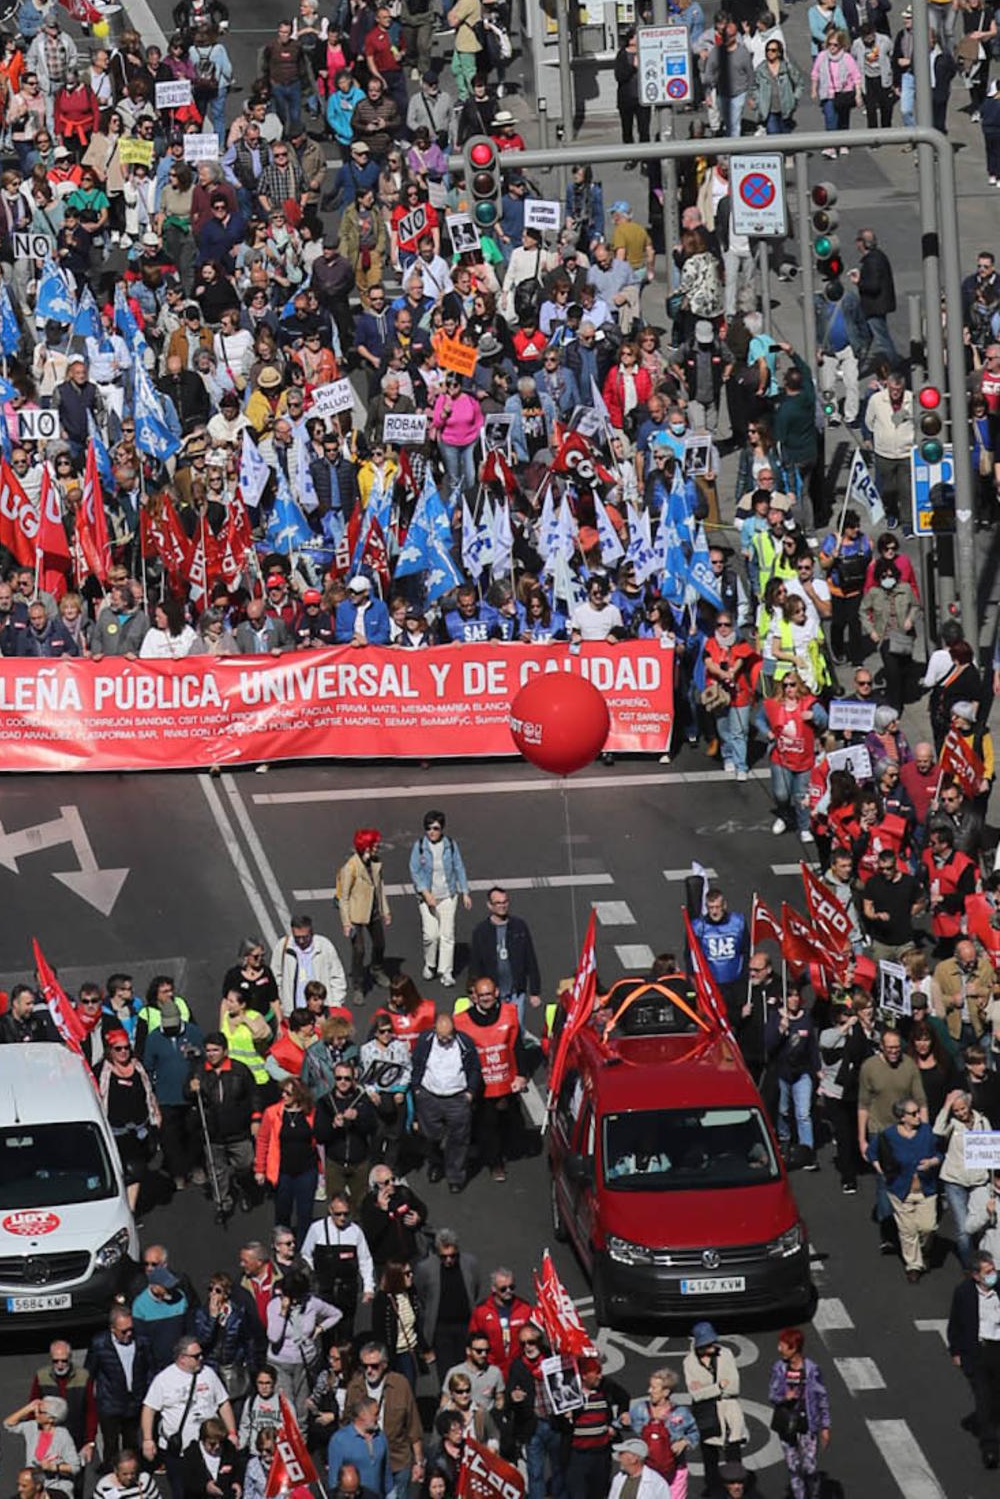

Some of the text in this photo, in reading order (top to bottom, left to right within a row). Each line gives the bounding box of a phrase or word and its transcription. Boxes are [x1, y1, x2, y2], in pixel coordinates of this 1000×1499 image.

[733, 161, 778, 171] EN ACERA
[399, 209, 426, 240] NO
[14, 233, 49, 257] NO
[18, 411, 56, 436] NO
[386, 416, 424, 432] ROBAN
[94, 668, 228, 713] PÚBLICA,
[237, 663, 418, 706] UNIVERSAL
[425, 664, 451, 698] Y
[462, 660, 508, 695] DE
[9, 1211, 51, 1223] UGT
[688, 1278, 743, 1292] 4147 KVM
[14, 1296, 45, 1311] 5684
